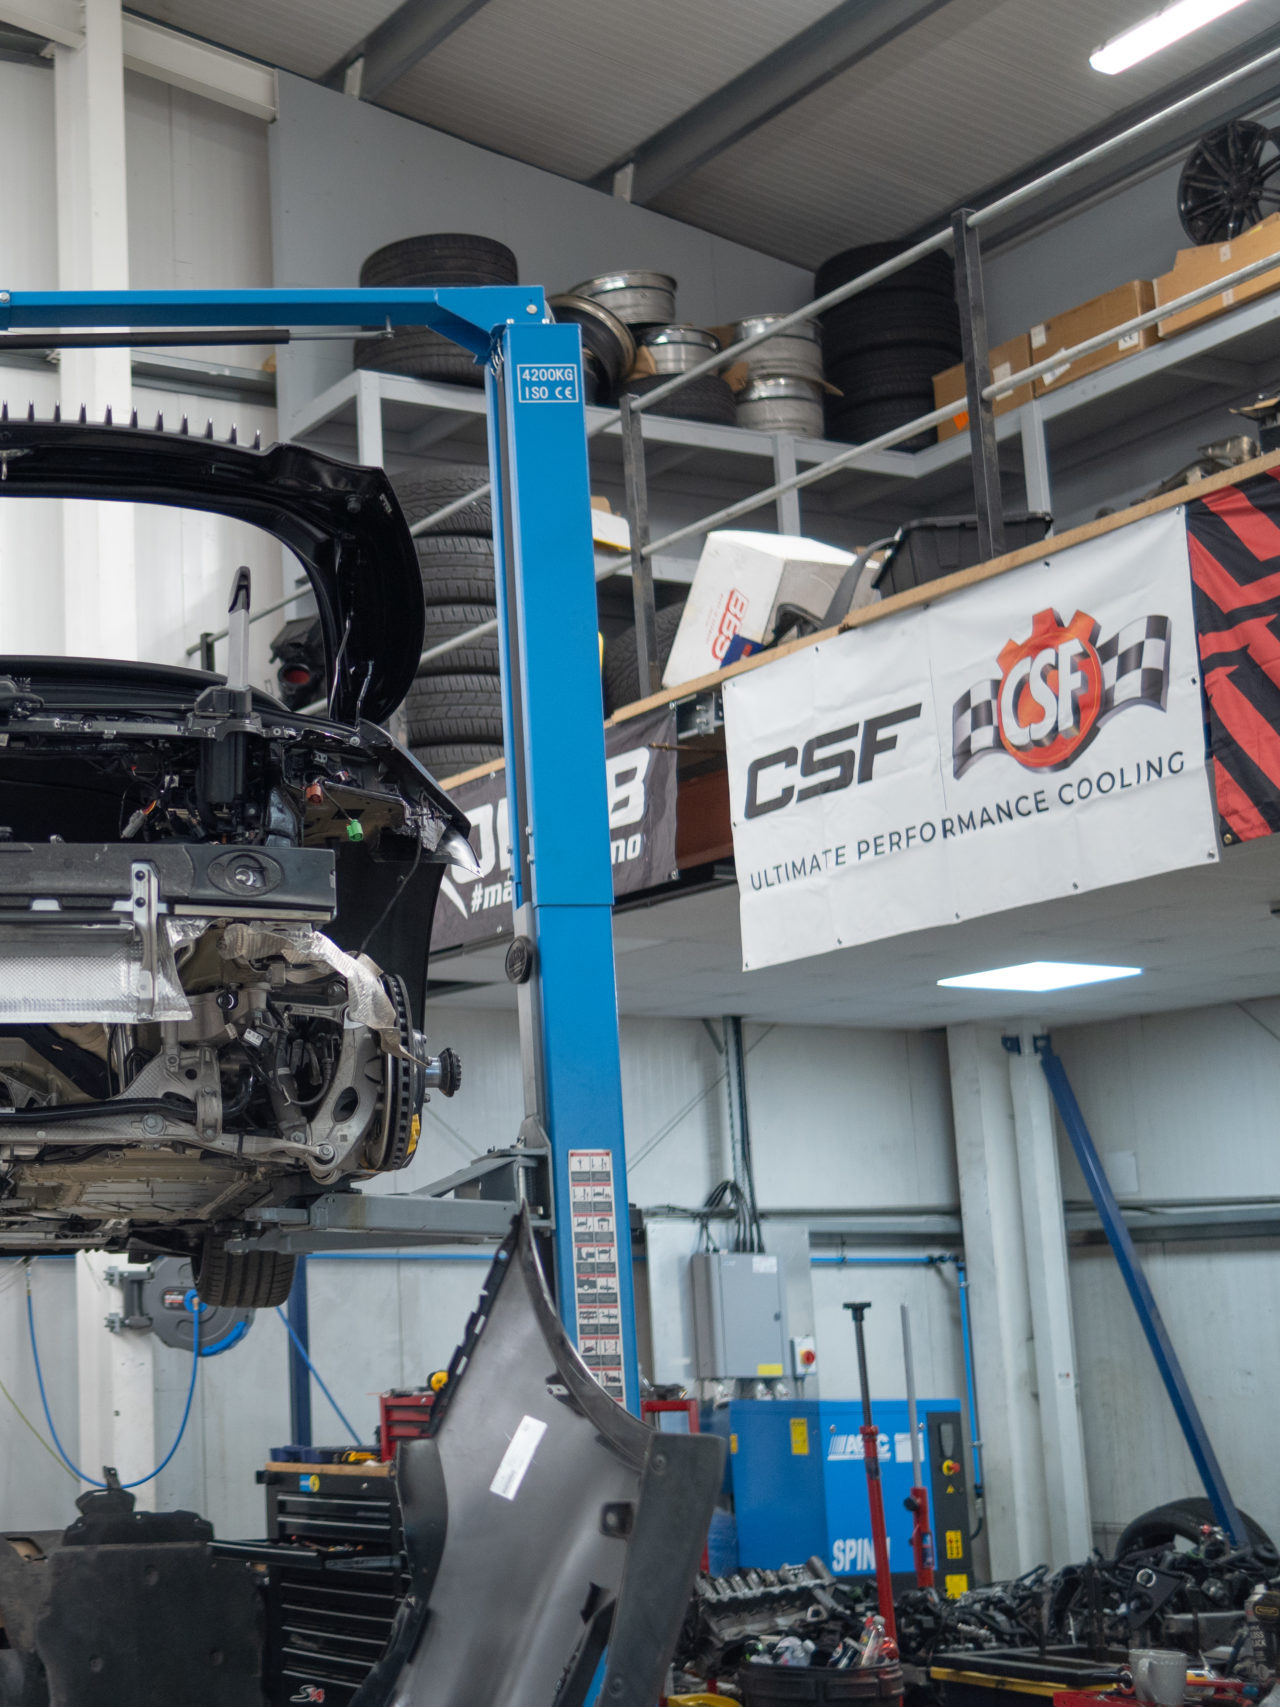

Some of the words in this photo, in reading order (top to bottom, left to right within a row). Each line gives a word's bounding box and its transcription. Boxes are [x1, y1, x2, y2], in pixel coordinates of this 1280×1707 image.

[522, 368, 574, 381] 4200KG
[525, 386, 549, 399] ISO
[999, 637, 1092, 750] CSF
[744, 702, 923, 820] CSF
[750, 845, 847, 892] ULTIMATE
[856, 789, 1050, 862] PERFORMANCE
[1058, 750, 1186, 806] COOLING
[832, 1536, 891, 1572] SPIN
